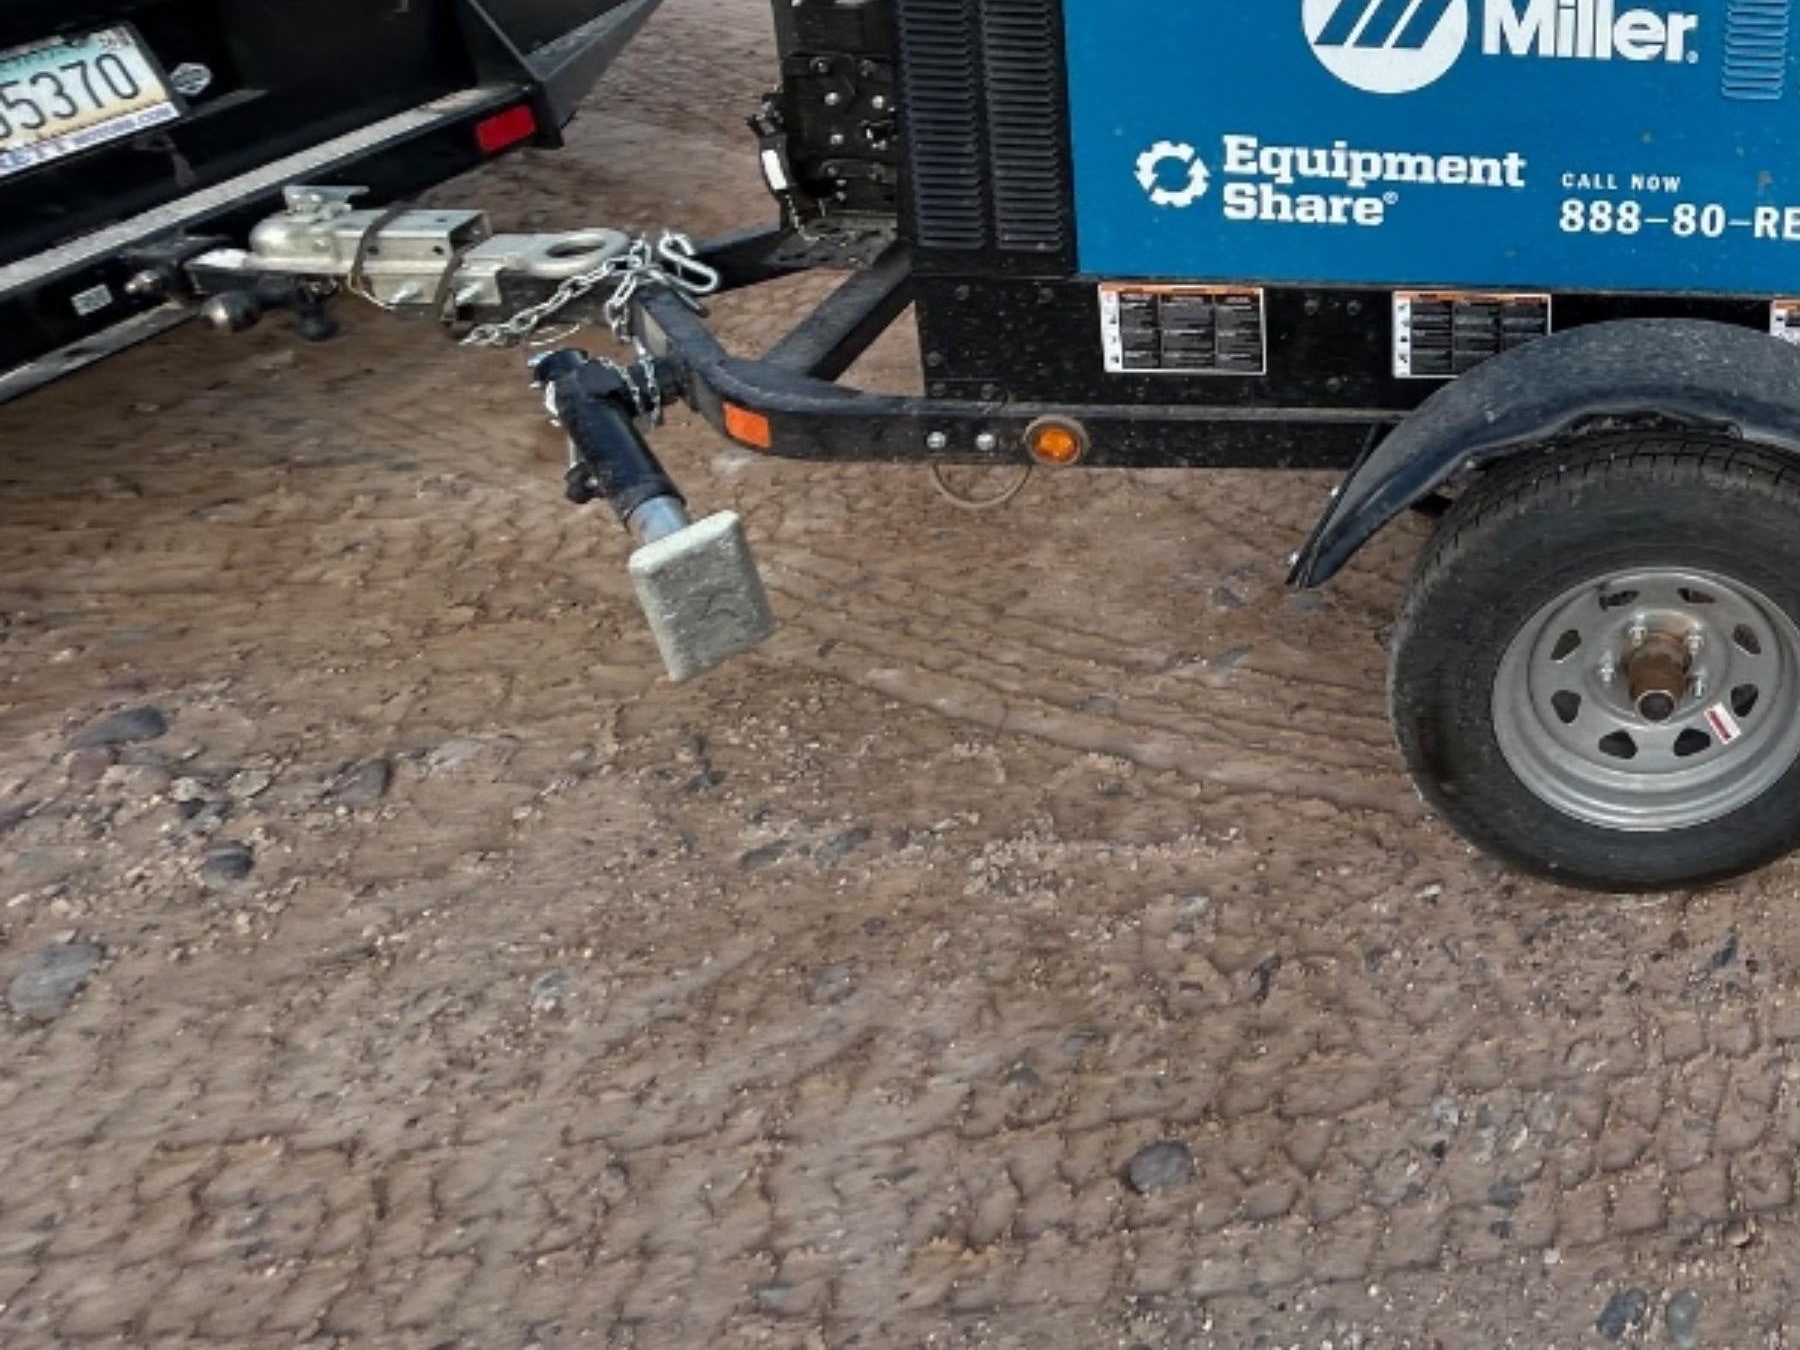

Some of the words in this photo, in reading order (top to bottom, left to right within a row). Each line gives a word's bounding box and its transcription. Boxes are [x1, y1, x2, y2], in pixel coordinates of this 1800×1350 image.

[1222, 134, 1527, 188] Equipment
[1561, 171, 1618, 191] CALL
[1630, 173, 1682, 193] NOW
